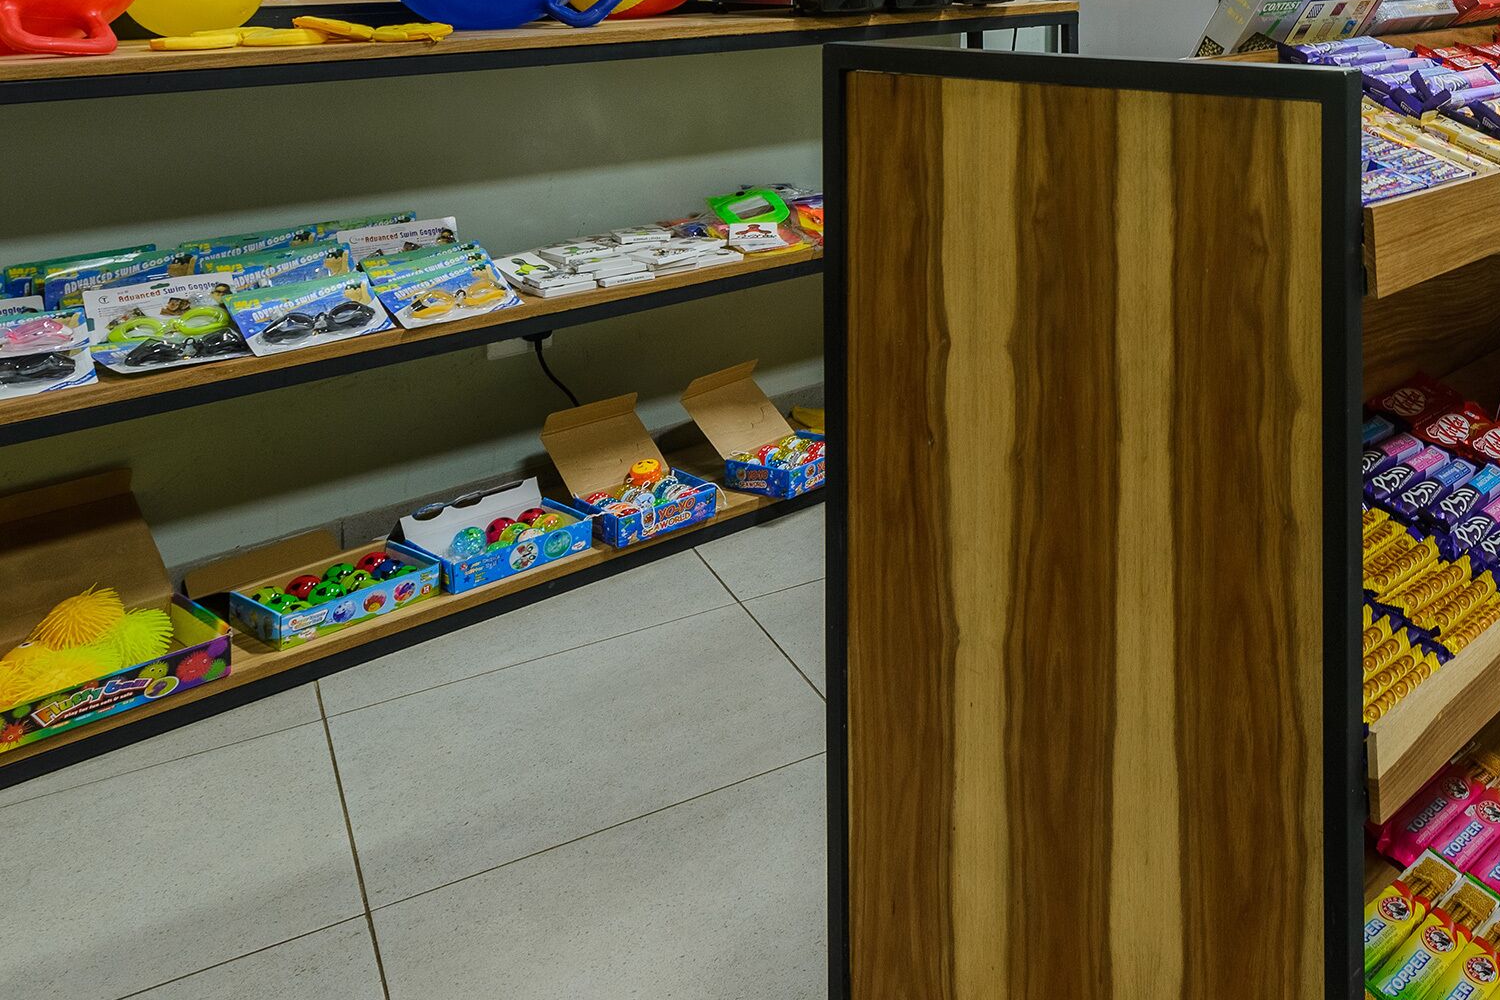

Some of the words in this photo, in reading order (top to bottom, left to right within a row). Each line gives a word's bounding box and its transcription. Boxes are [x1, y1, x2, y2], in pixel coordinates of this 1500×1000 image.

[243, 240, 265, 253] SWIM
[365, 233, 398, 243] Advanced
[400, 229, 417, 239] Swim
[277, 257, 300, 271] SWIM
[64, 272, 113, 294] ADVANCED
[114, 263, 141, 280] SWIM
[429, 273, 450, 287] SWIM
[119, 290, 161, 303] Advanced
[164, 285, 186, 295] Swim
[252, 302, 294, 323] ADVANCED
[295, 290, 318, 306] SWIM
[658, 497, 696, 519] YO-YO
[642, 512, 691, 536] SEAWORLD
[1407, 798, 1448, 833] TOPPER
[1443, 819, 1484, 858] TOPPER
[1364, 918, 1386, 943] PER
[1382, 949, 1431, 996] TOPPER
[1449, 981, 1474, 1000] PER
